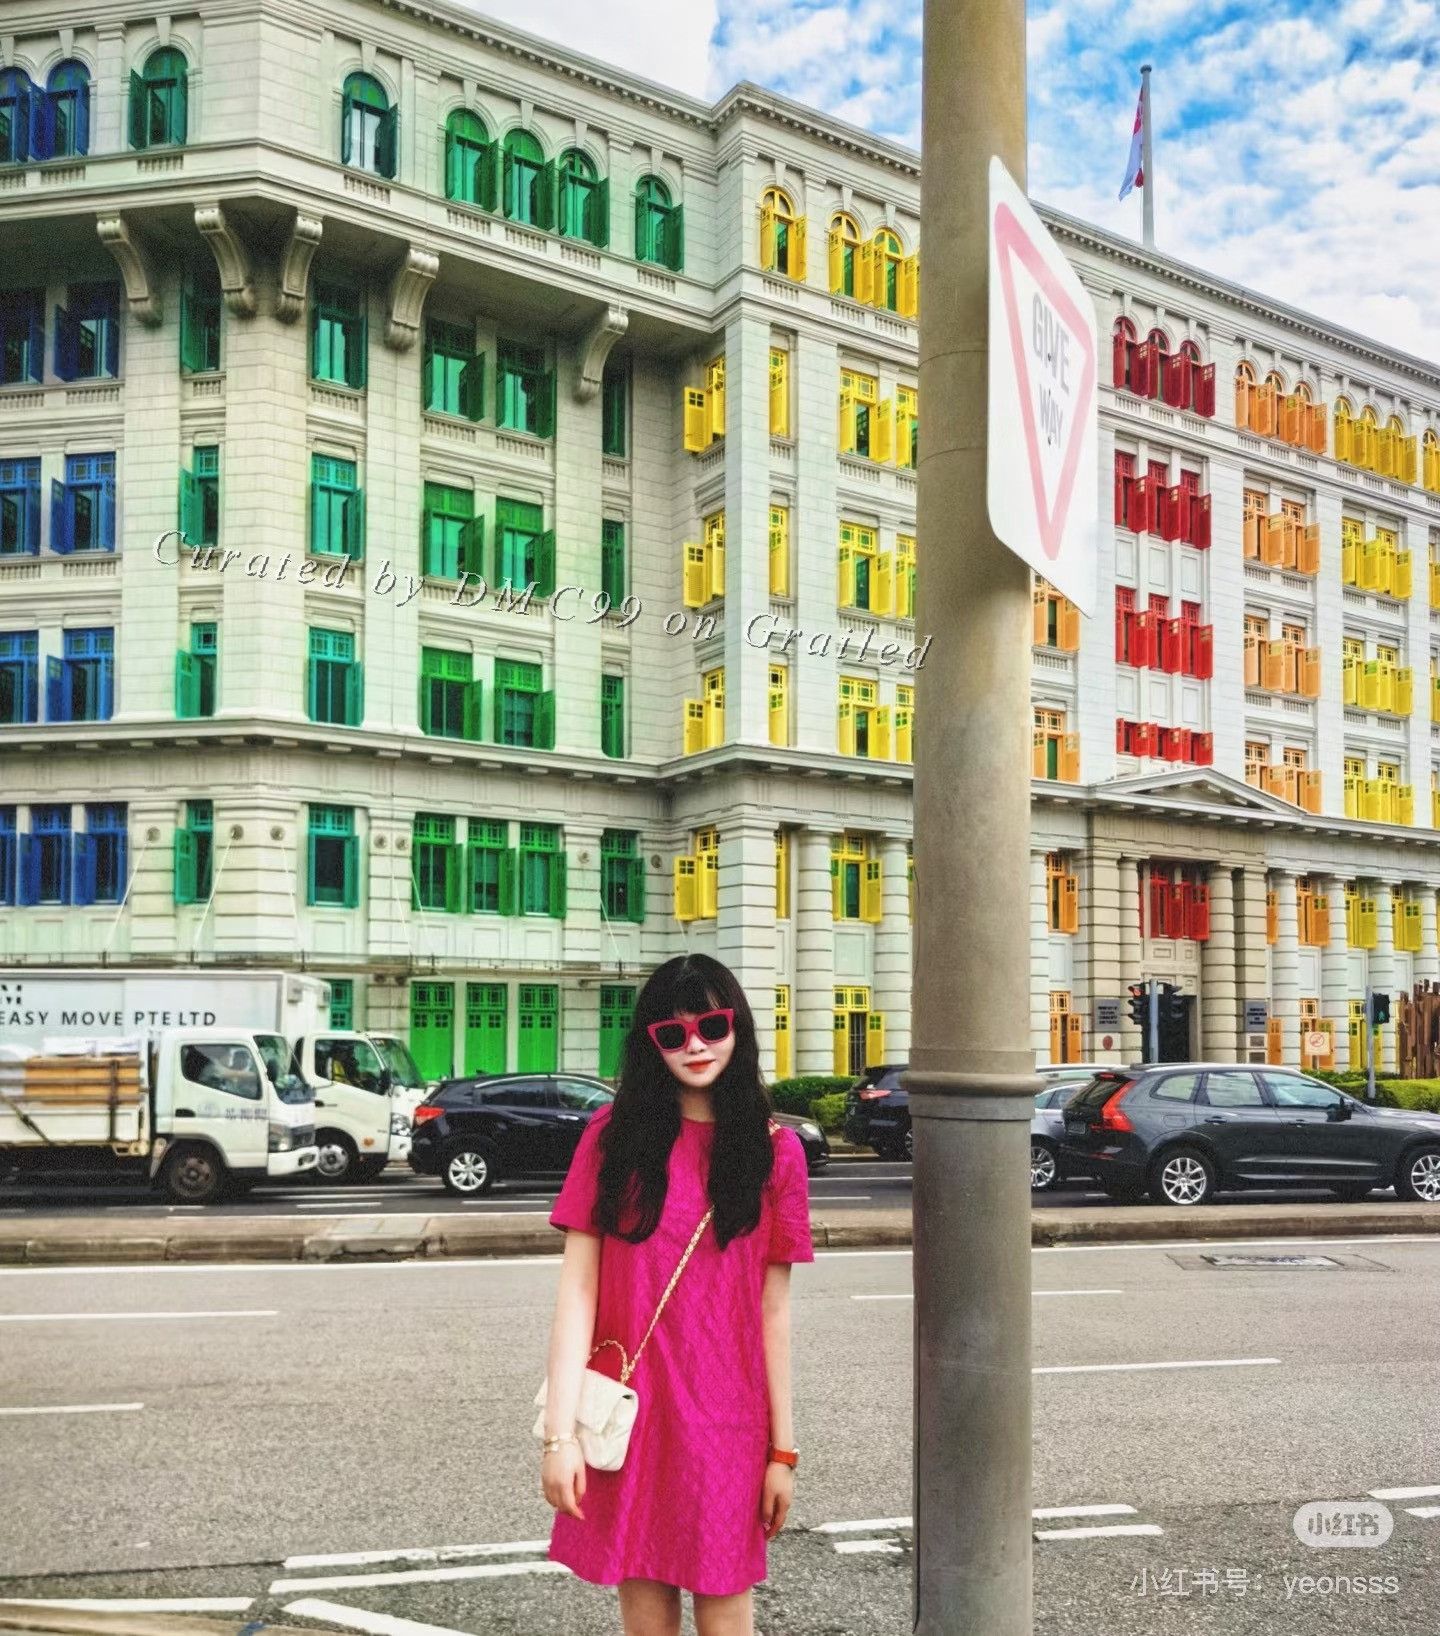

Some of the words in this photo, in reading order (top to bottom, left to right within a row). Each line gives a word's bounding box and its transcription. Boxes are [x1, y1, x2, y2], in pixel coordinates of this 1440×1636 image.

[1032, 292, 1069, 394] GIVE
[1039, 383, 1063, 448] WAY
[0, 1010, 49, 1026] EASY
[61, 1010, 123, 1026] MOVE
[134, 1010, 171, 1026] PTE
[178, 1010, 216, 1026] LTD
